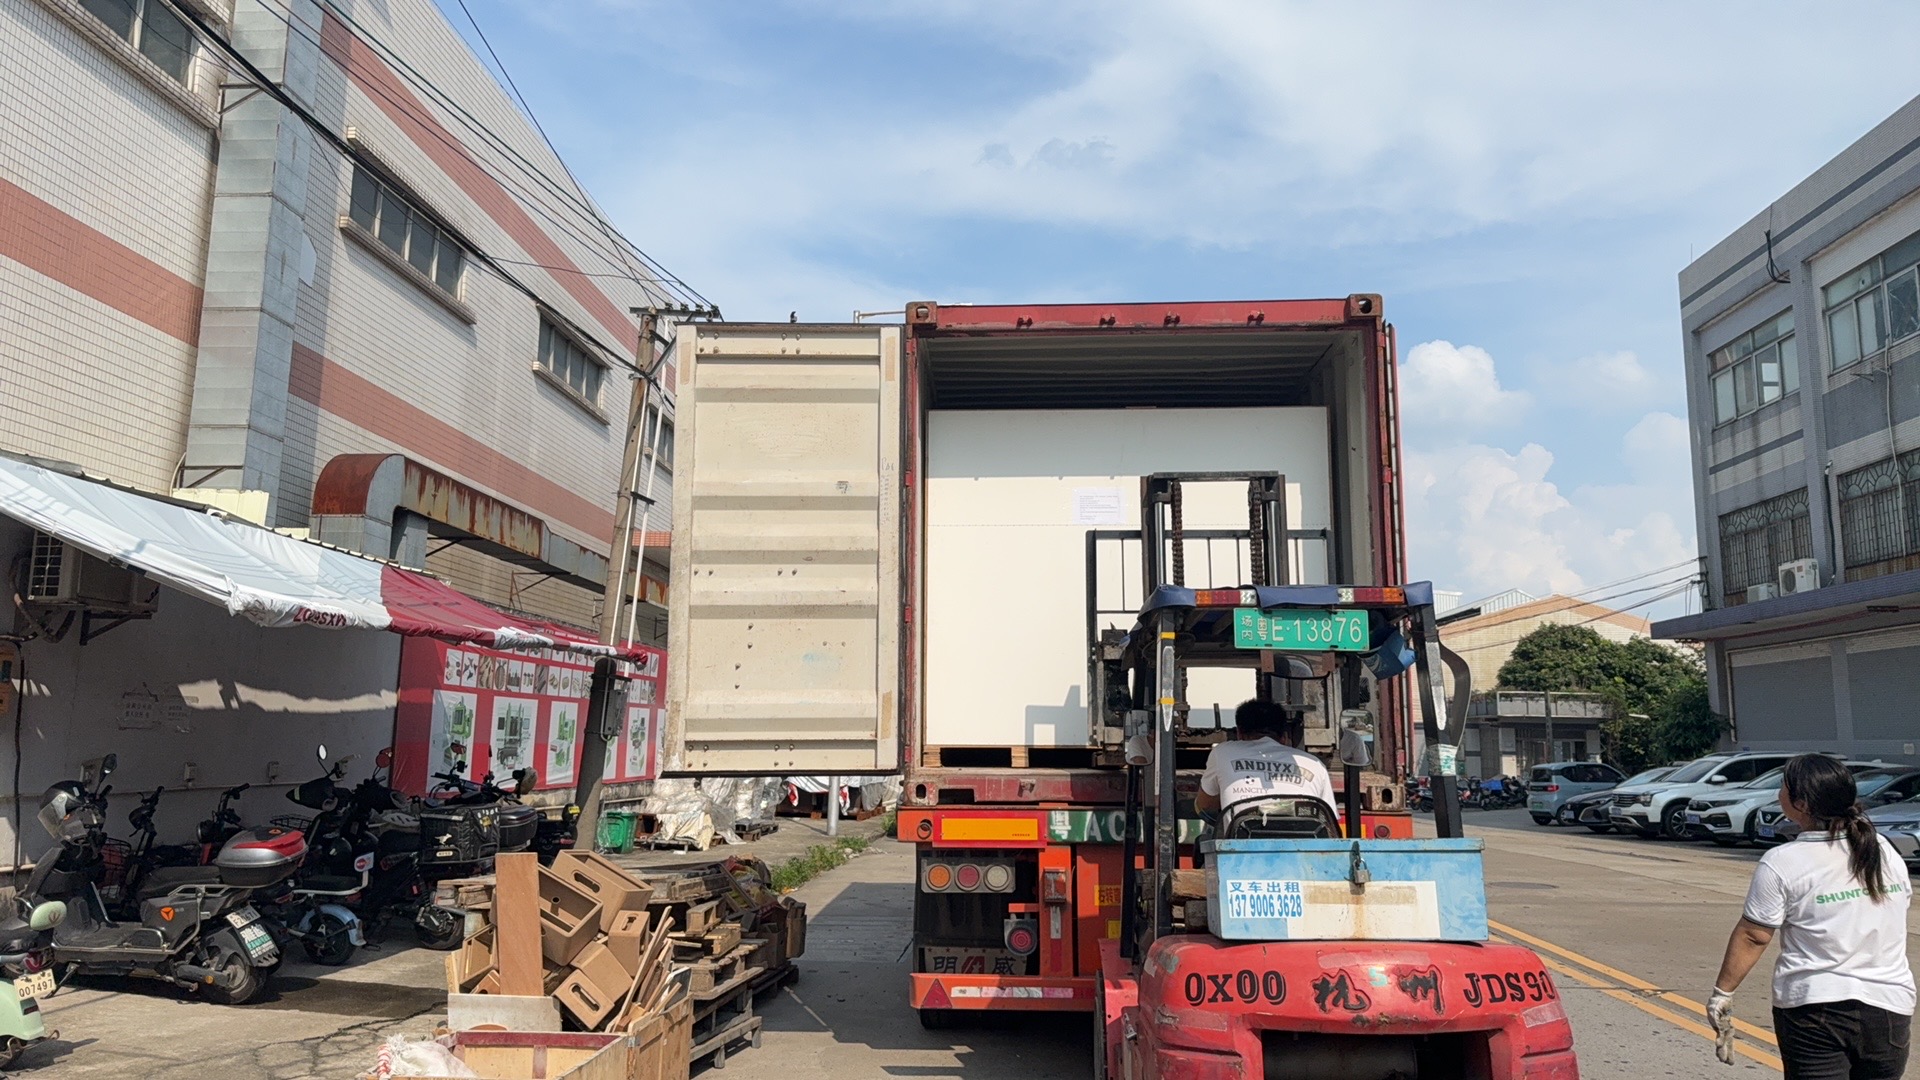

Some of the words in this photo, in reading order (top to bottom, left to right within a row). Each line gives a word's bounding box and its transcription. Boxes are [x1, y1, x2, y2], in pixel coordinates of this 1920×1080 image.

[1268, 772, 1302, 785] MIND
[1232, 787, 1270, 795] MANCITY
[1229, 881, 1301, 893] 叉车出租
[19, 979, 53, 997] 007497
